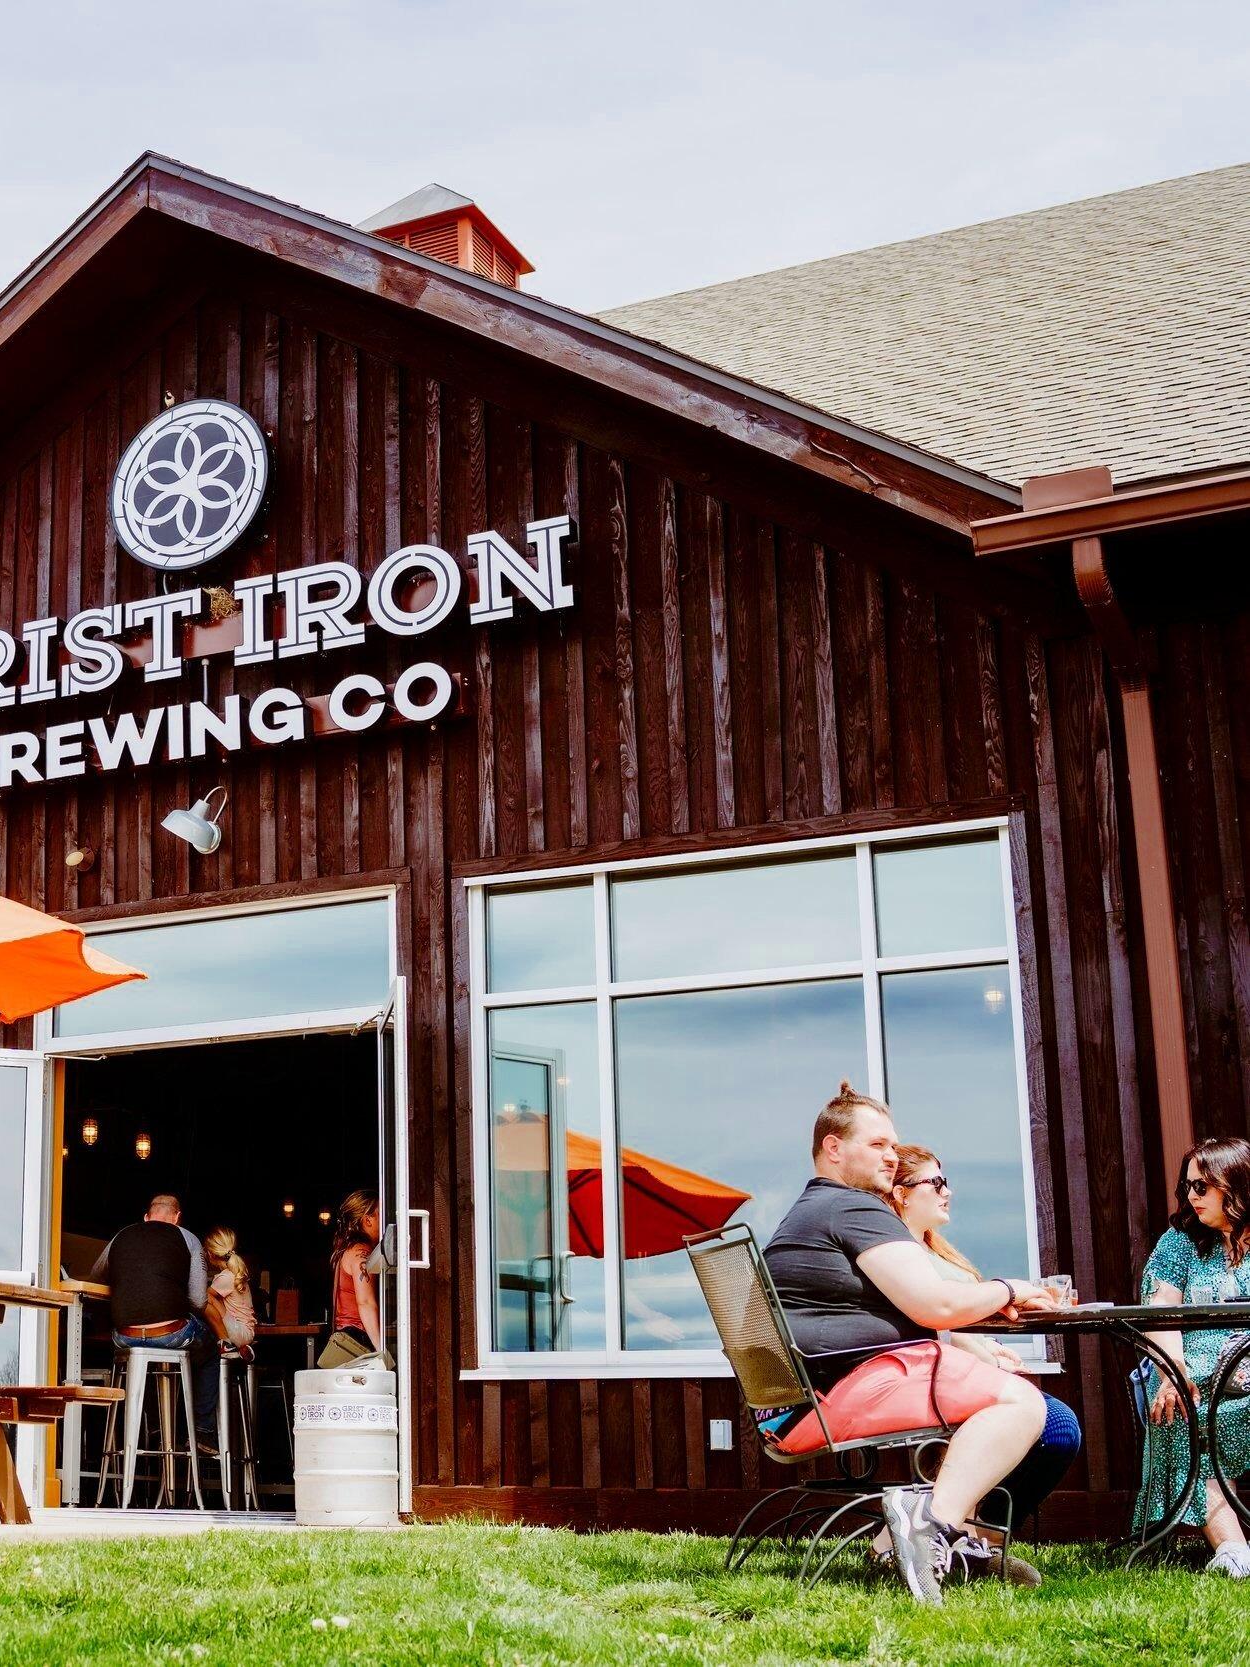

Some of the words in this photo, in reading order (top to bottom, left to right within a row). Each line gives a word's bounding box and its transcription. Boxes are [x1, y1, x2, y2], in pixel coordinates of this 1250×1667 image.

[234, 515, 575, 666] IRON
[329, 662, 452, 731] CO
[343, 1411, 364, 1419] IRON
